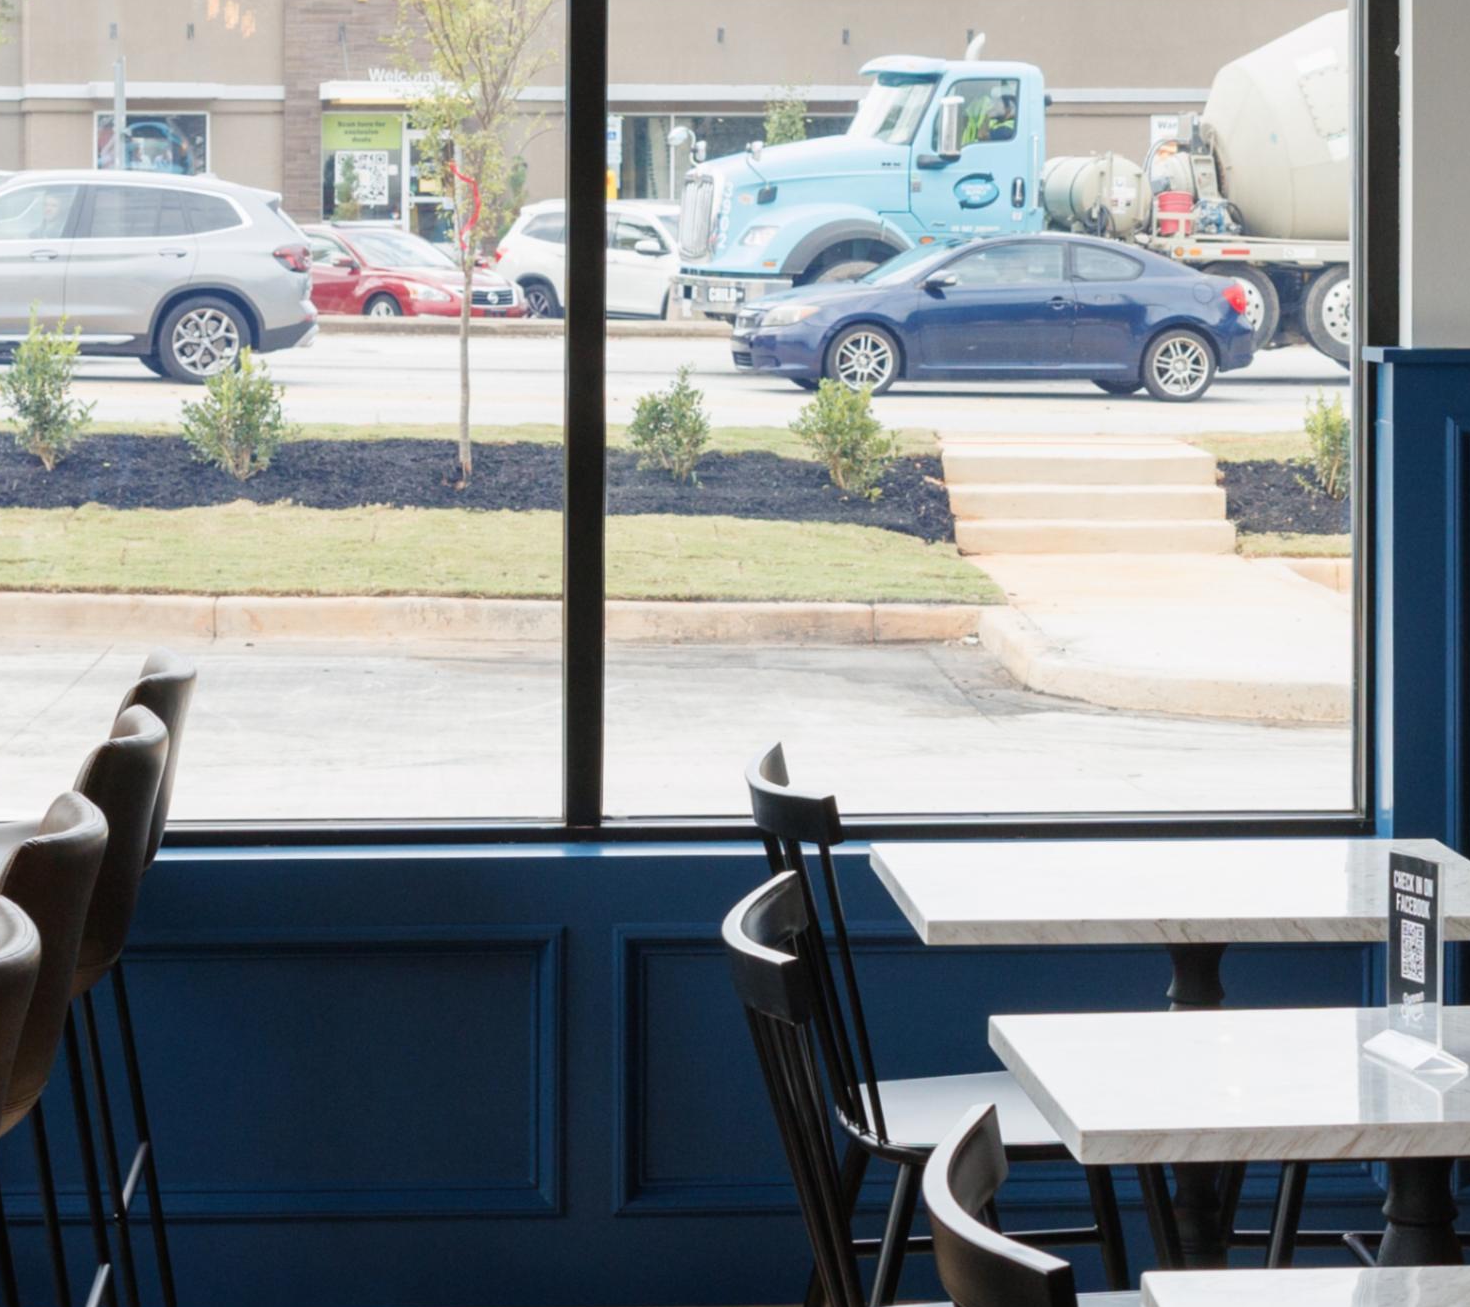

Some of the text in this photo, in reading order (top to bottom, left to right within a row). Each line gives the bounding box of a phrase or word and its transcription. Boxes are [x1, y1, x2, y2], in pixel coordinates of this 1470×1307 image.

[1393, 870, 1434, 898] CHECK IN ON
[1396, 893, 1431, 920] FACEBOOK
